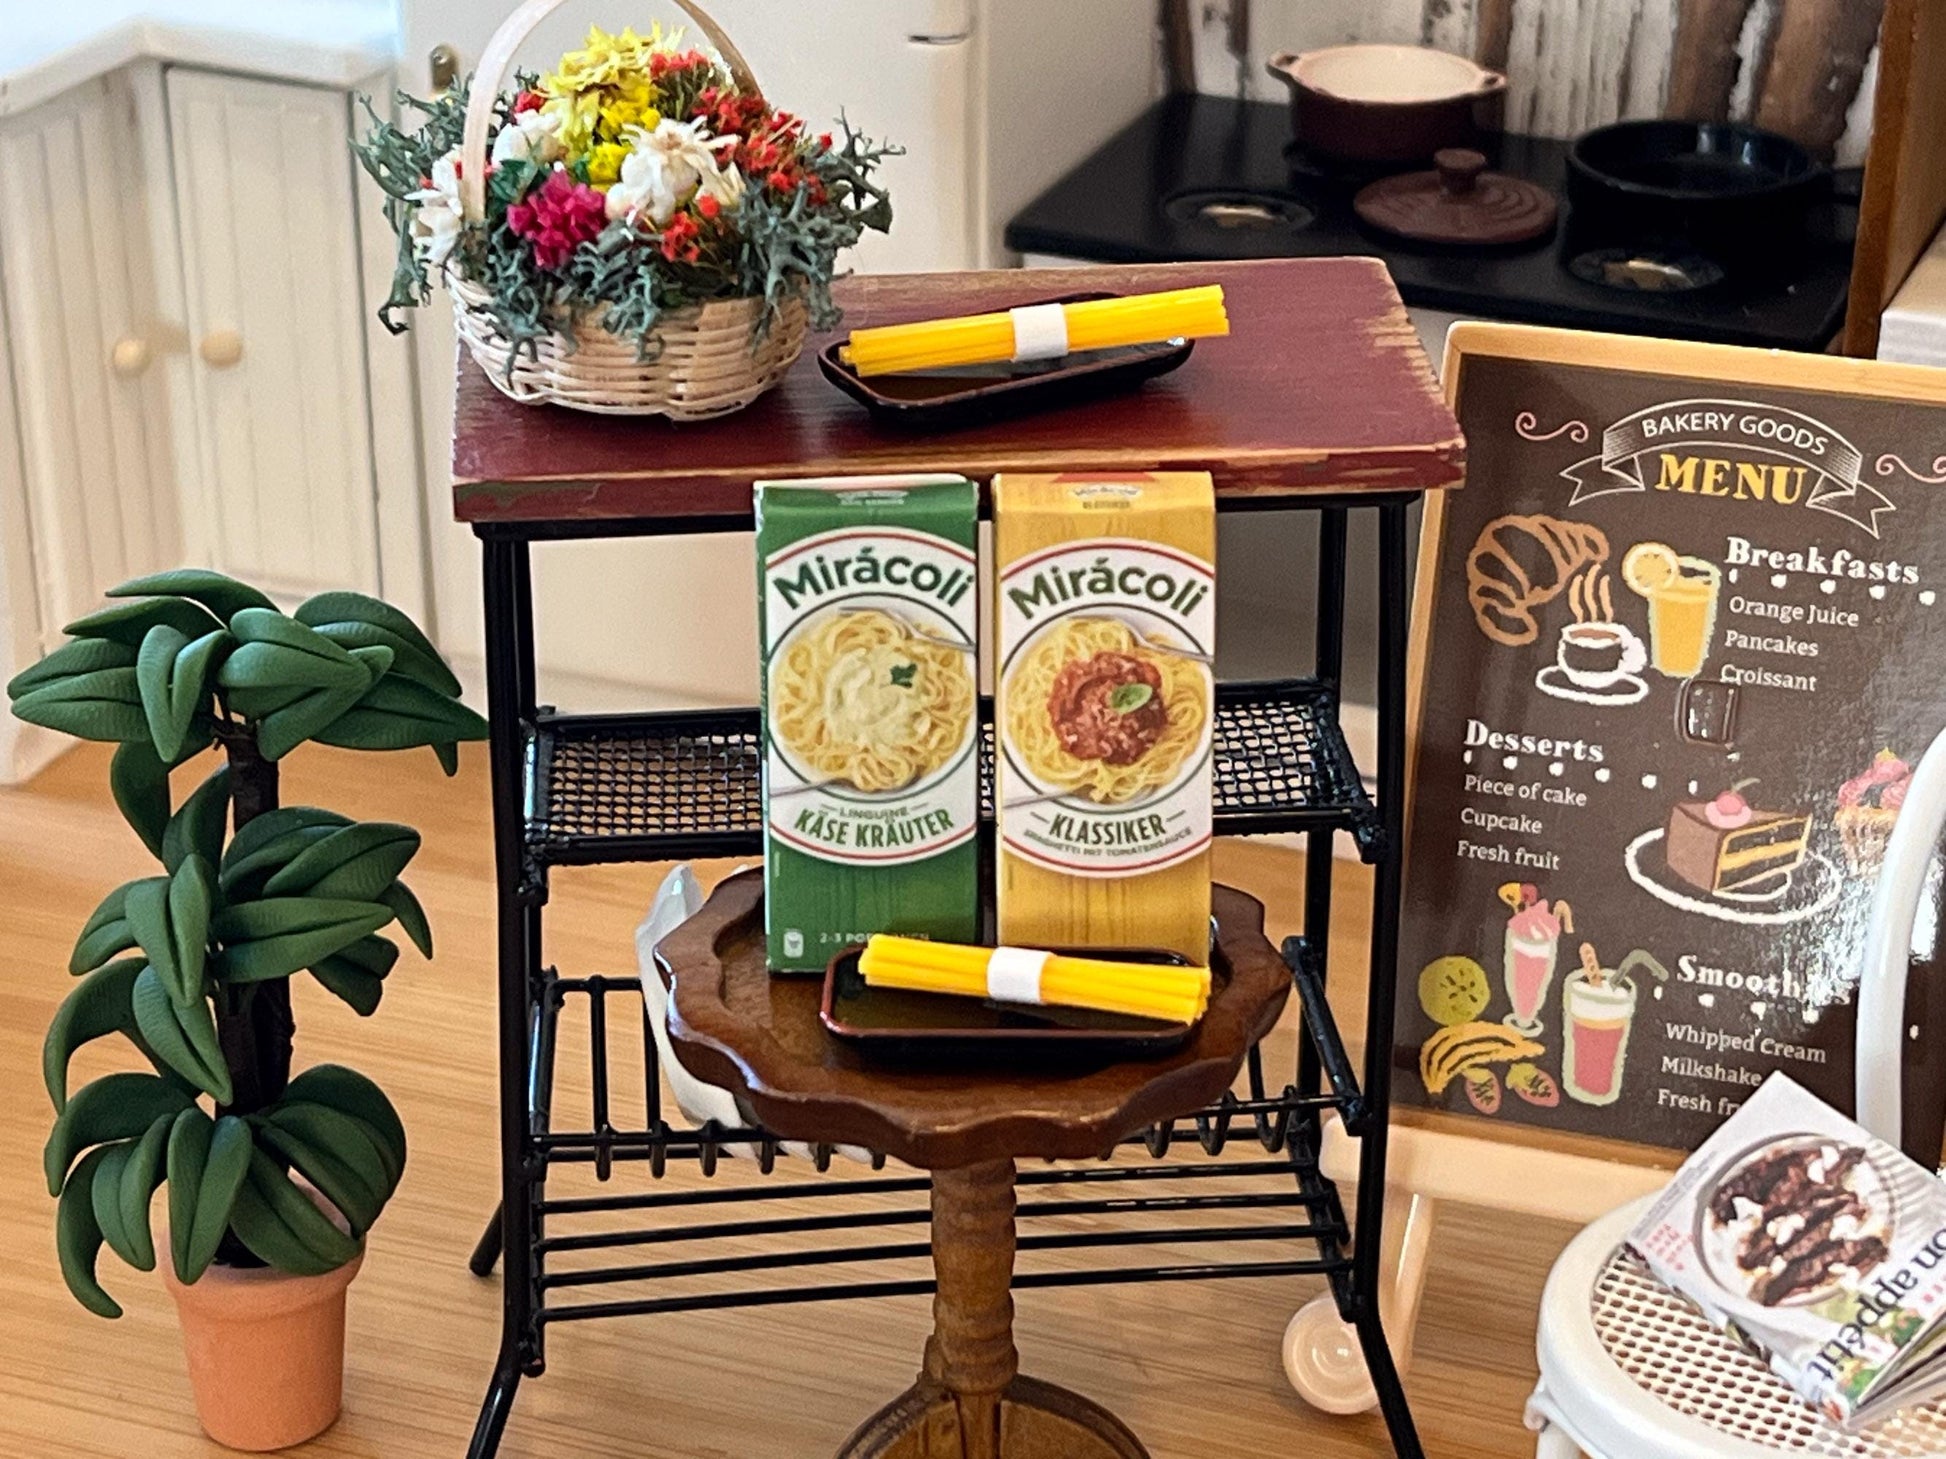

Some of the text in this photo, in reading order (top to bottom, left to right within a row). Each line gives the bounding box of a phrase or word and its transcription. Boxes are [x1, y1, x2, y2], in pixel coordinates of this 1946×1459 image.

[1642, 412, 1829, 455] BAKERY GOODS
[1655, 454, 1807, 505] MENU
[773, 546, 975, 610] Mirácoli
[1724, 536, 1920, 584] Breakfasts
[1008, 557, 1208, 620] Mirácoli
[1729, 596, 1859, 627] Orange Juice
[1724, 630, 1819, 657] Pancakes
[1720, 664, 1817, 692] Croissant
[1464, 719, 1604, 763] Desserts
[1464, 774, 1588, 806] Piece of cake
[794, 808, 954, 847] KÄSE KRÄUTER
[1048, 813, 1166, 845] KLASSIKER
[1461, 807, 1543, 834] Cupcake
[1457, 840, 1560, 871] Fresh fruit
[1677, 955, 1815, 1000] Smooth
[1666, 1022, 1827, 1063] Whipped Cream
[1661, 1056, 1763, 1086] Milkshake
[1657, 1089, 1712, 1113] Fresh
[1807, 1268, 1918, 1381] appétit
